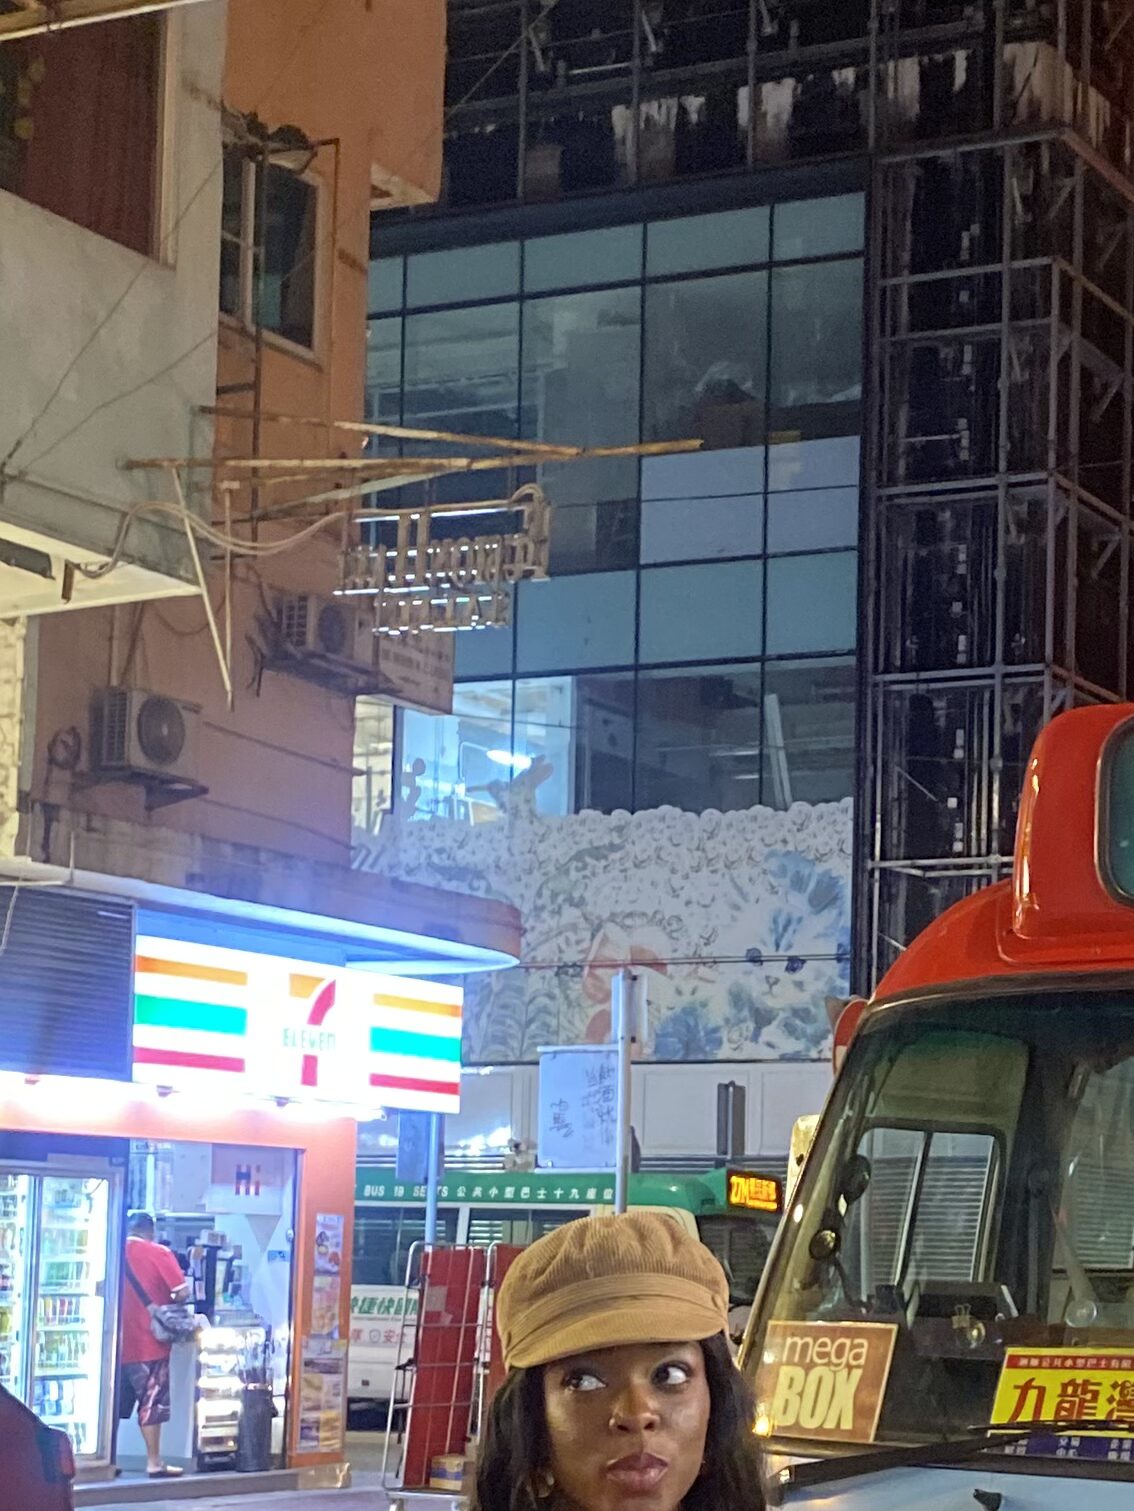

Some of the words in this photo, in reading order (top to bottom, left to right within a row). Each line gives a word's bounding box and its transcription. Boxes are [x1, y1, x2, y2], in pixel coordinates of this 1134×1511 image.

[363, 1184, 385, 1196] BUS
[784, 1333, 868, 1372] mega
[776, 1365, 862, 1431] BOX
